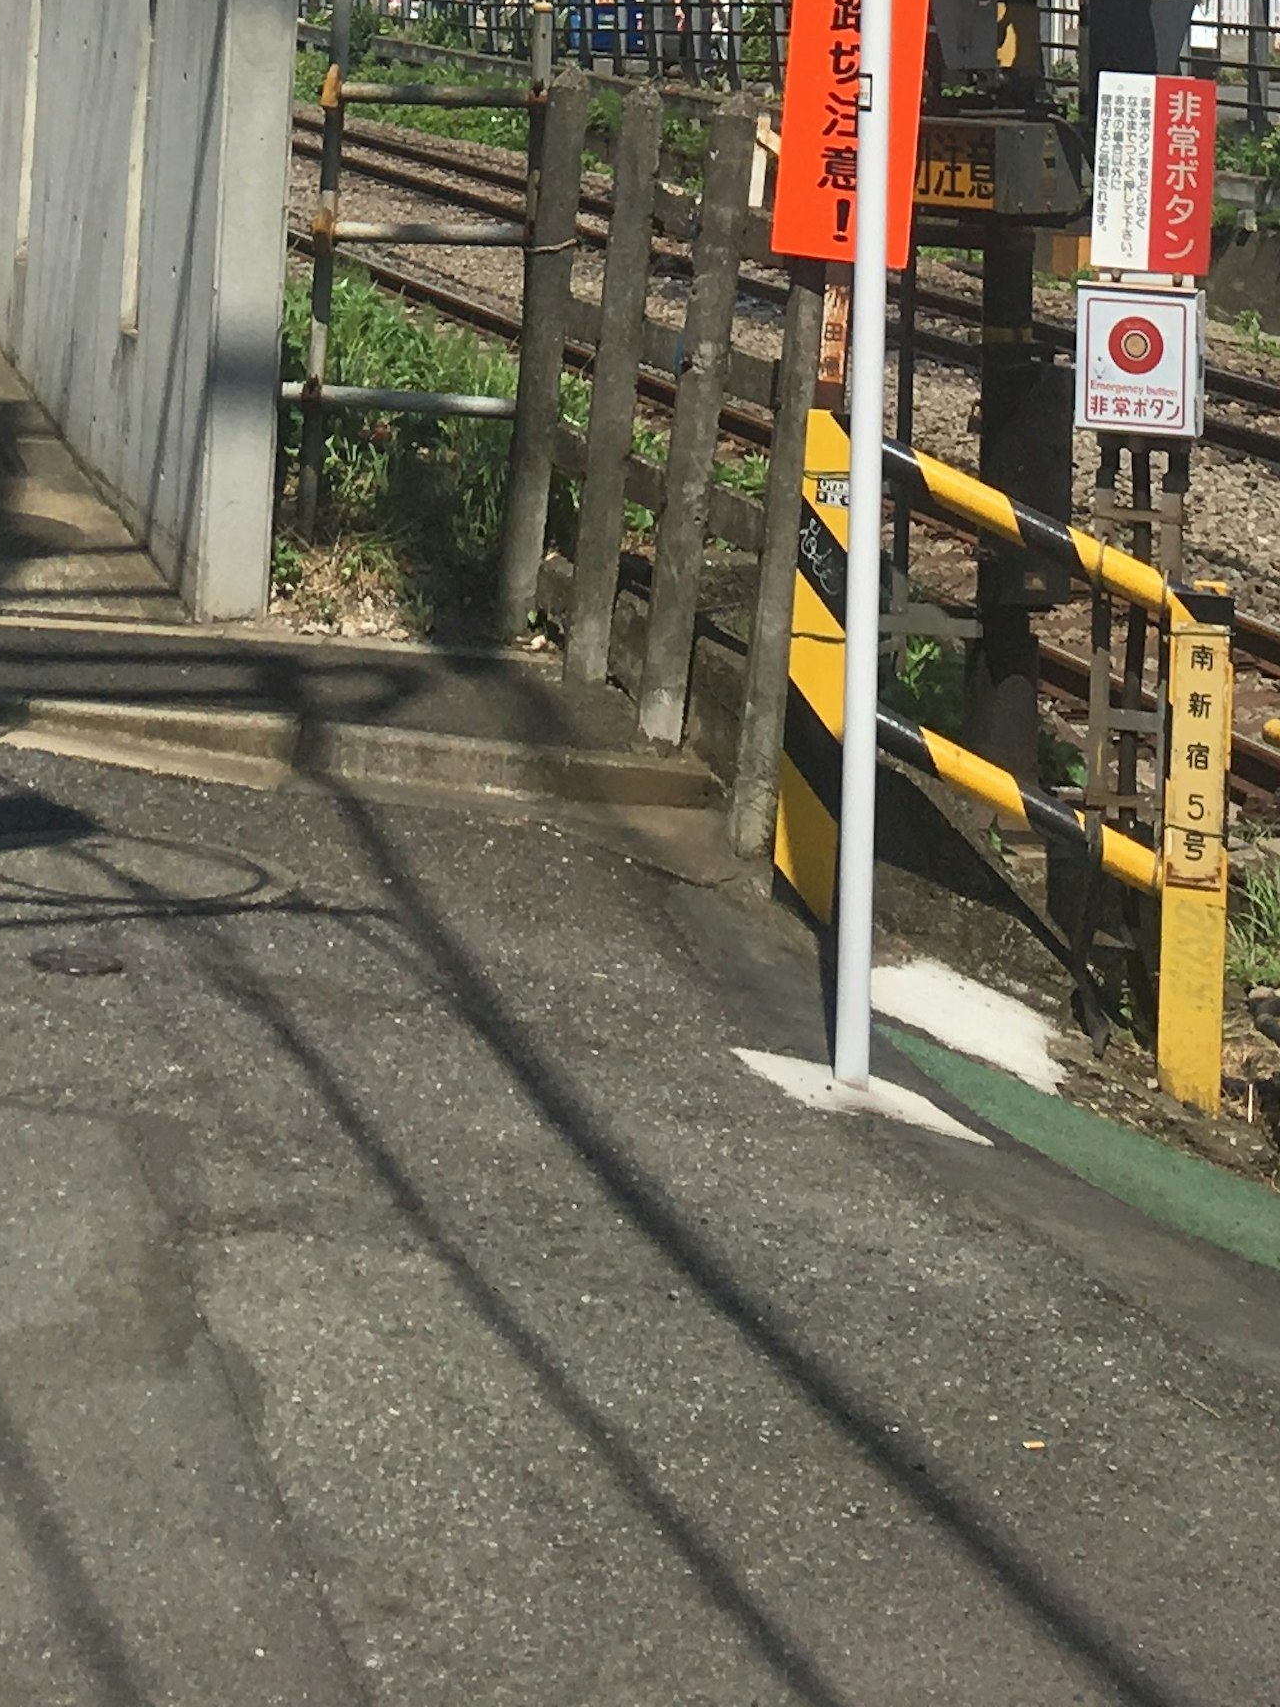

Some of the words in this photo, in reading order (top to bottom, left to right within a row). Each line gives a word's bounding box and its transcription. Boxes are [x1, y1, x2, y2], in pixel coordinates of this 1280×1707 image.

[1164, 90, 1202, 259] 非常ボタン
[1090, 380, 1144, 396] Emergency
[1146, 385, 1178, 397] button
[1090, 394, 1180, 421] 非常ボタン
[1183, 644, 1215, 862] 南新宿5号
